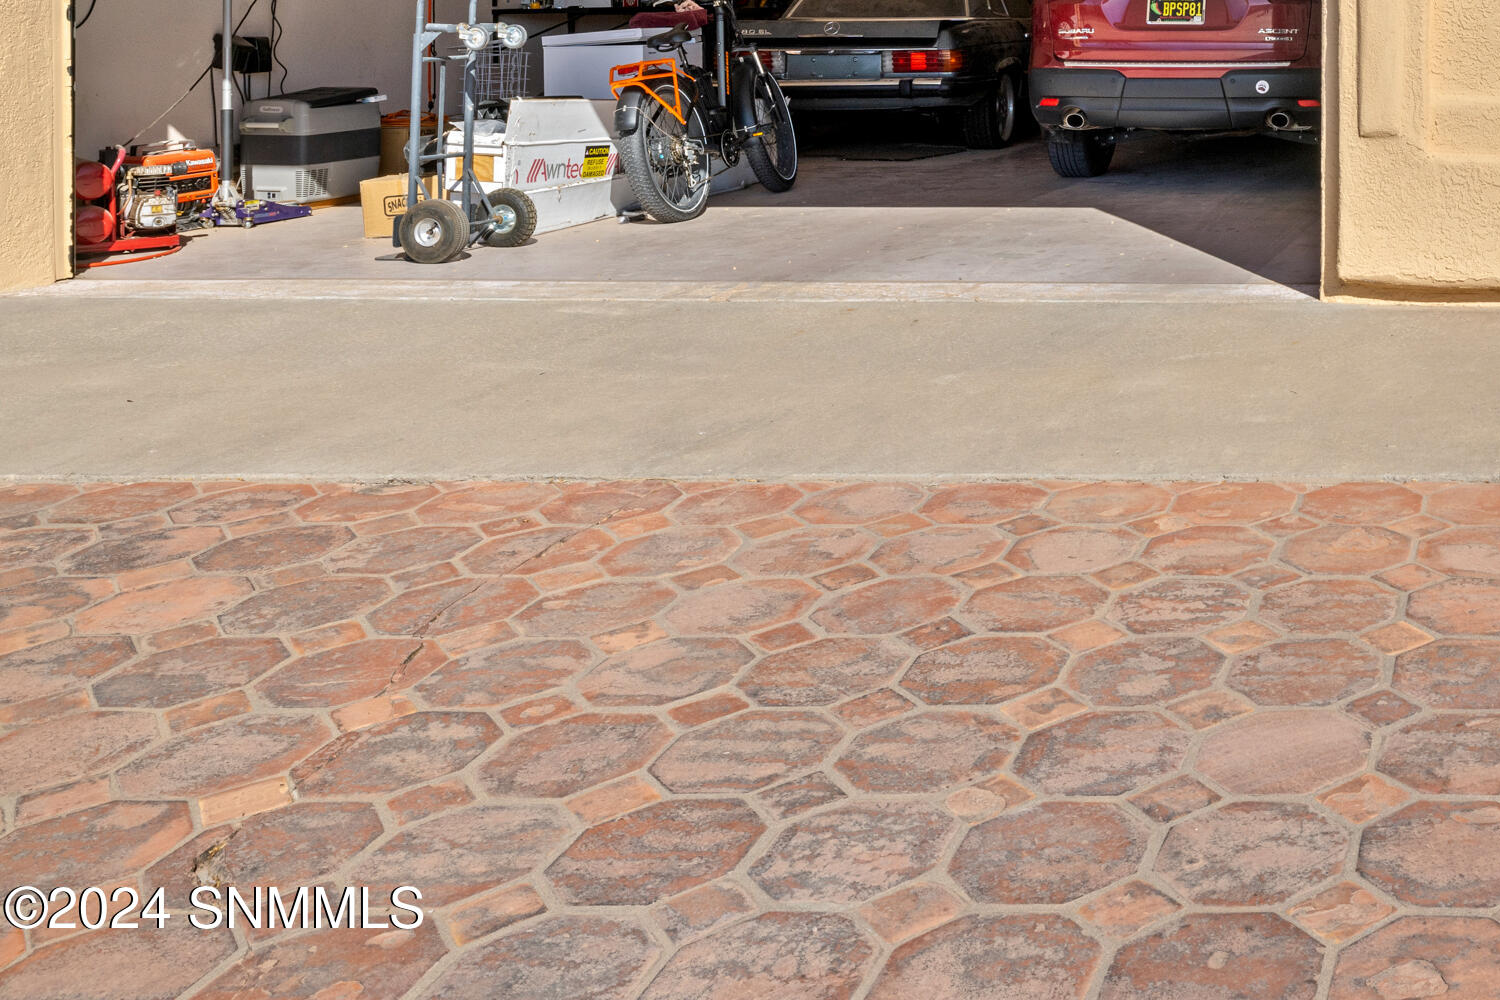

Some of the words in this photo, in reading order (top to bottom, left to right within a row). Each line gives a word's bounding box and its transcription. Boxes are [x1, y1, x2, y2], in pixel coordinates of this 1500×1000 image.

[1162, 1, 1203, 17] BPSP81
[588, 147, 609, 155] CAUTION
[185, 157, 214, 167] Kawasaki
[526, 158, 584, 183] Awntec
[387, 197, 408, 212] SNAC
